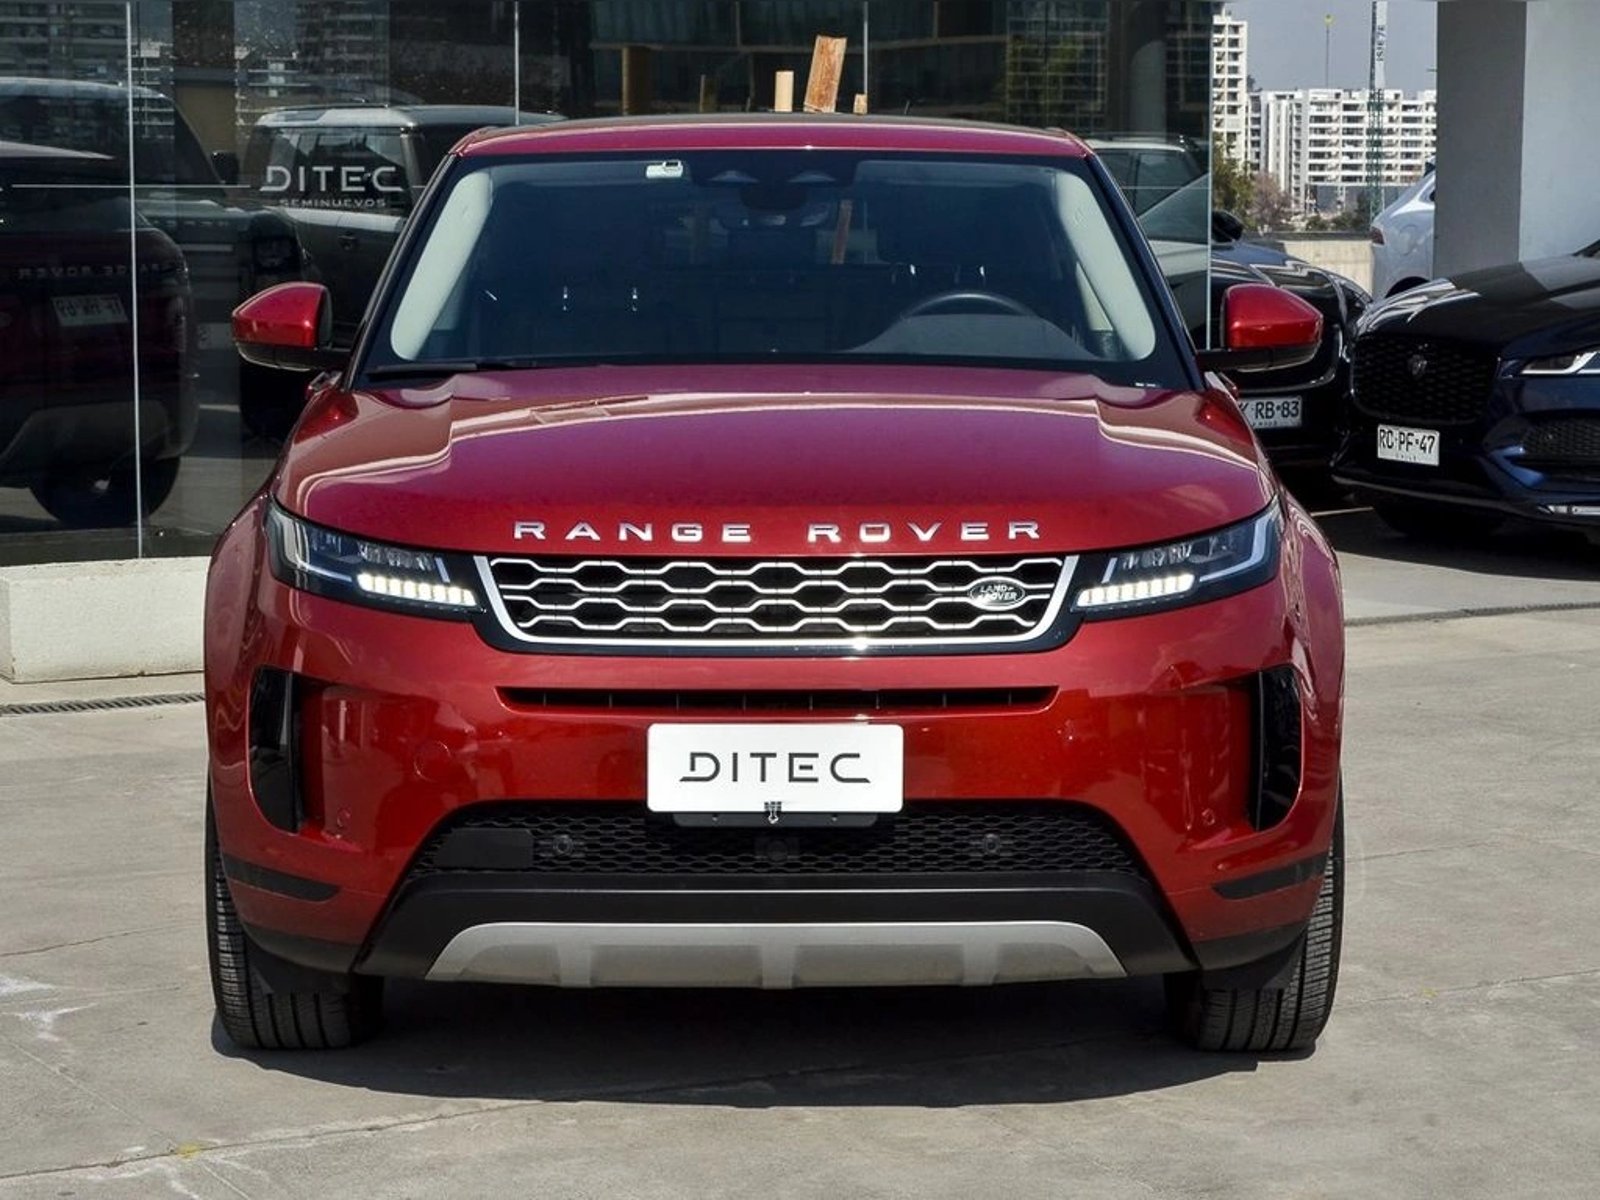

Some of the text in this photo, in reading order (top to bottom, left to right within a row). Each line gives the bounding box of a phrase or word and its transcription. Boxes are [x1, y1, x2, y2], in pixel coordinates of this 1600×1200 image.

[259, 165, 404, 192] DITEC
[279, 199, 386, 208] SEMINUEVOS
[513, 521, 1040, 543] RANGE ROVER
[679, 752, 871, 783] DITEC
